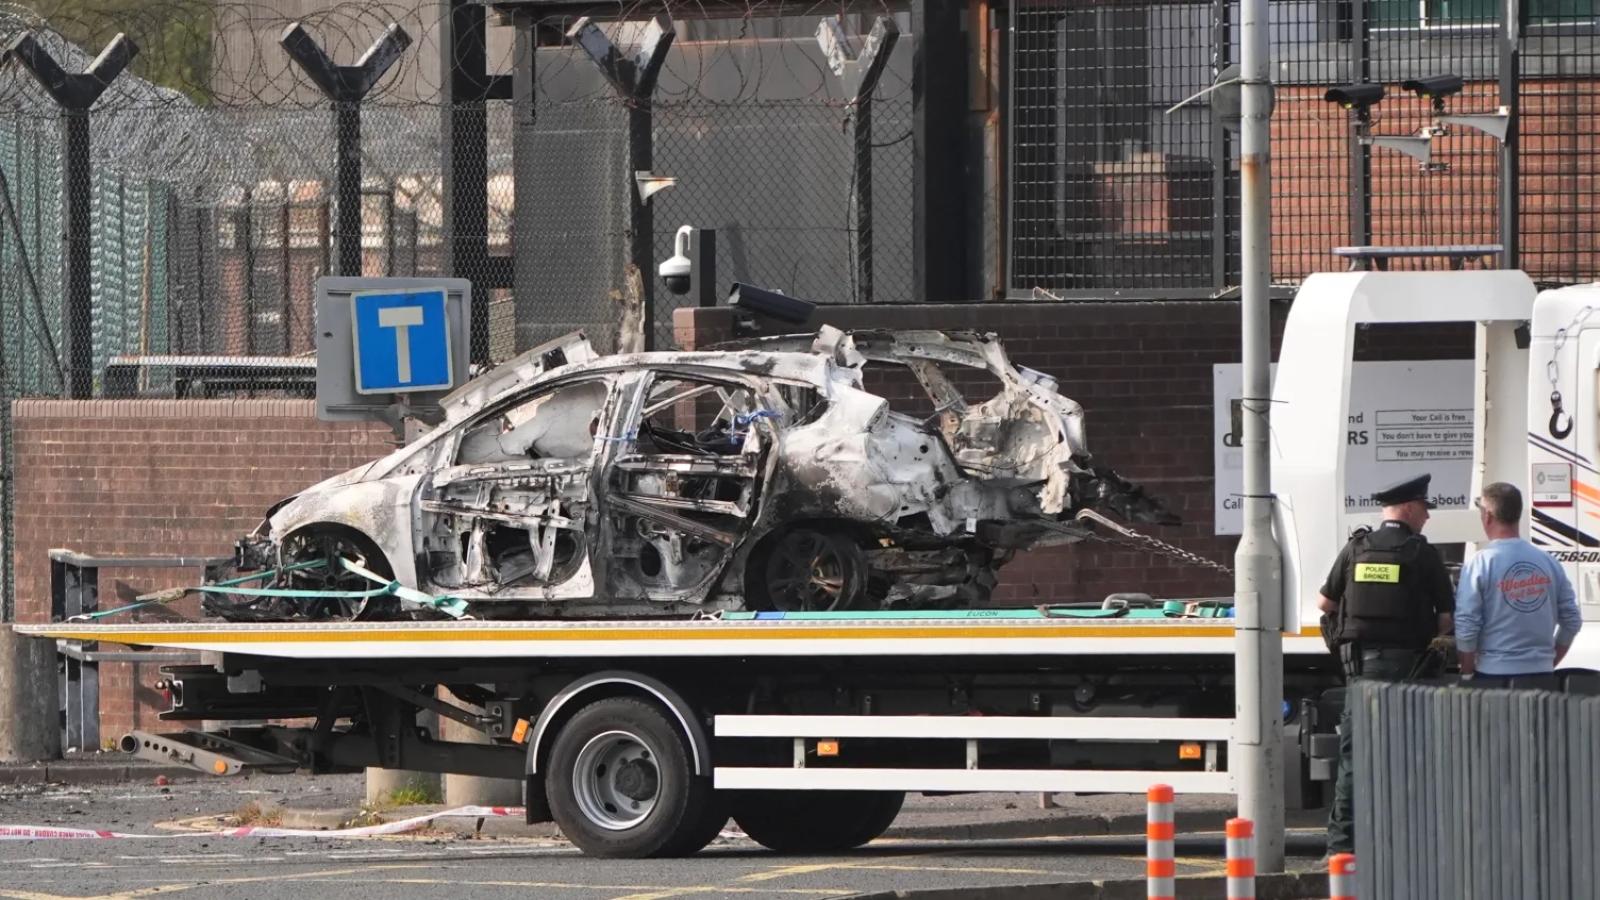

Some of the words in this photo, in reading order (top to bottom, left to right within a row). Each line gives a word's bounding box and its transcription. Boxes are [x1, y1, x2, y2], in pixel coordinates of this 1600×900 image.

[1348, 411, 1363, 424] nd
[1412, 414, 1428, 422] Your
[1347, 431, 1369, 446] RS
[1416, 431, 1432, 440] have
[1459, 432, 1474, 440] you
[1396, 450, 1409, 458] You
[1410, 450, 1425, 458] may
[1223, 497, 1243, 510] Cal
[1345, 495, 1356, 507] th
[1359, 495, 1381, 507] info
[1431, 493, 1466, 506] about
[1363, 573, 1391, 581] BRONZE
